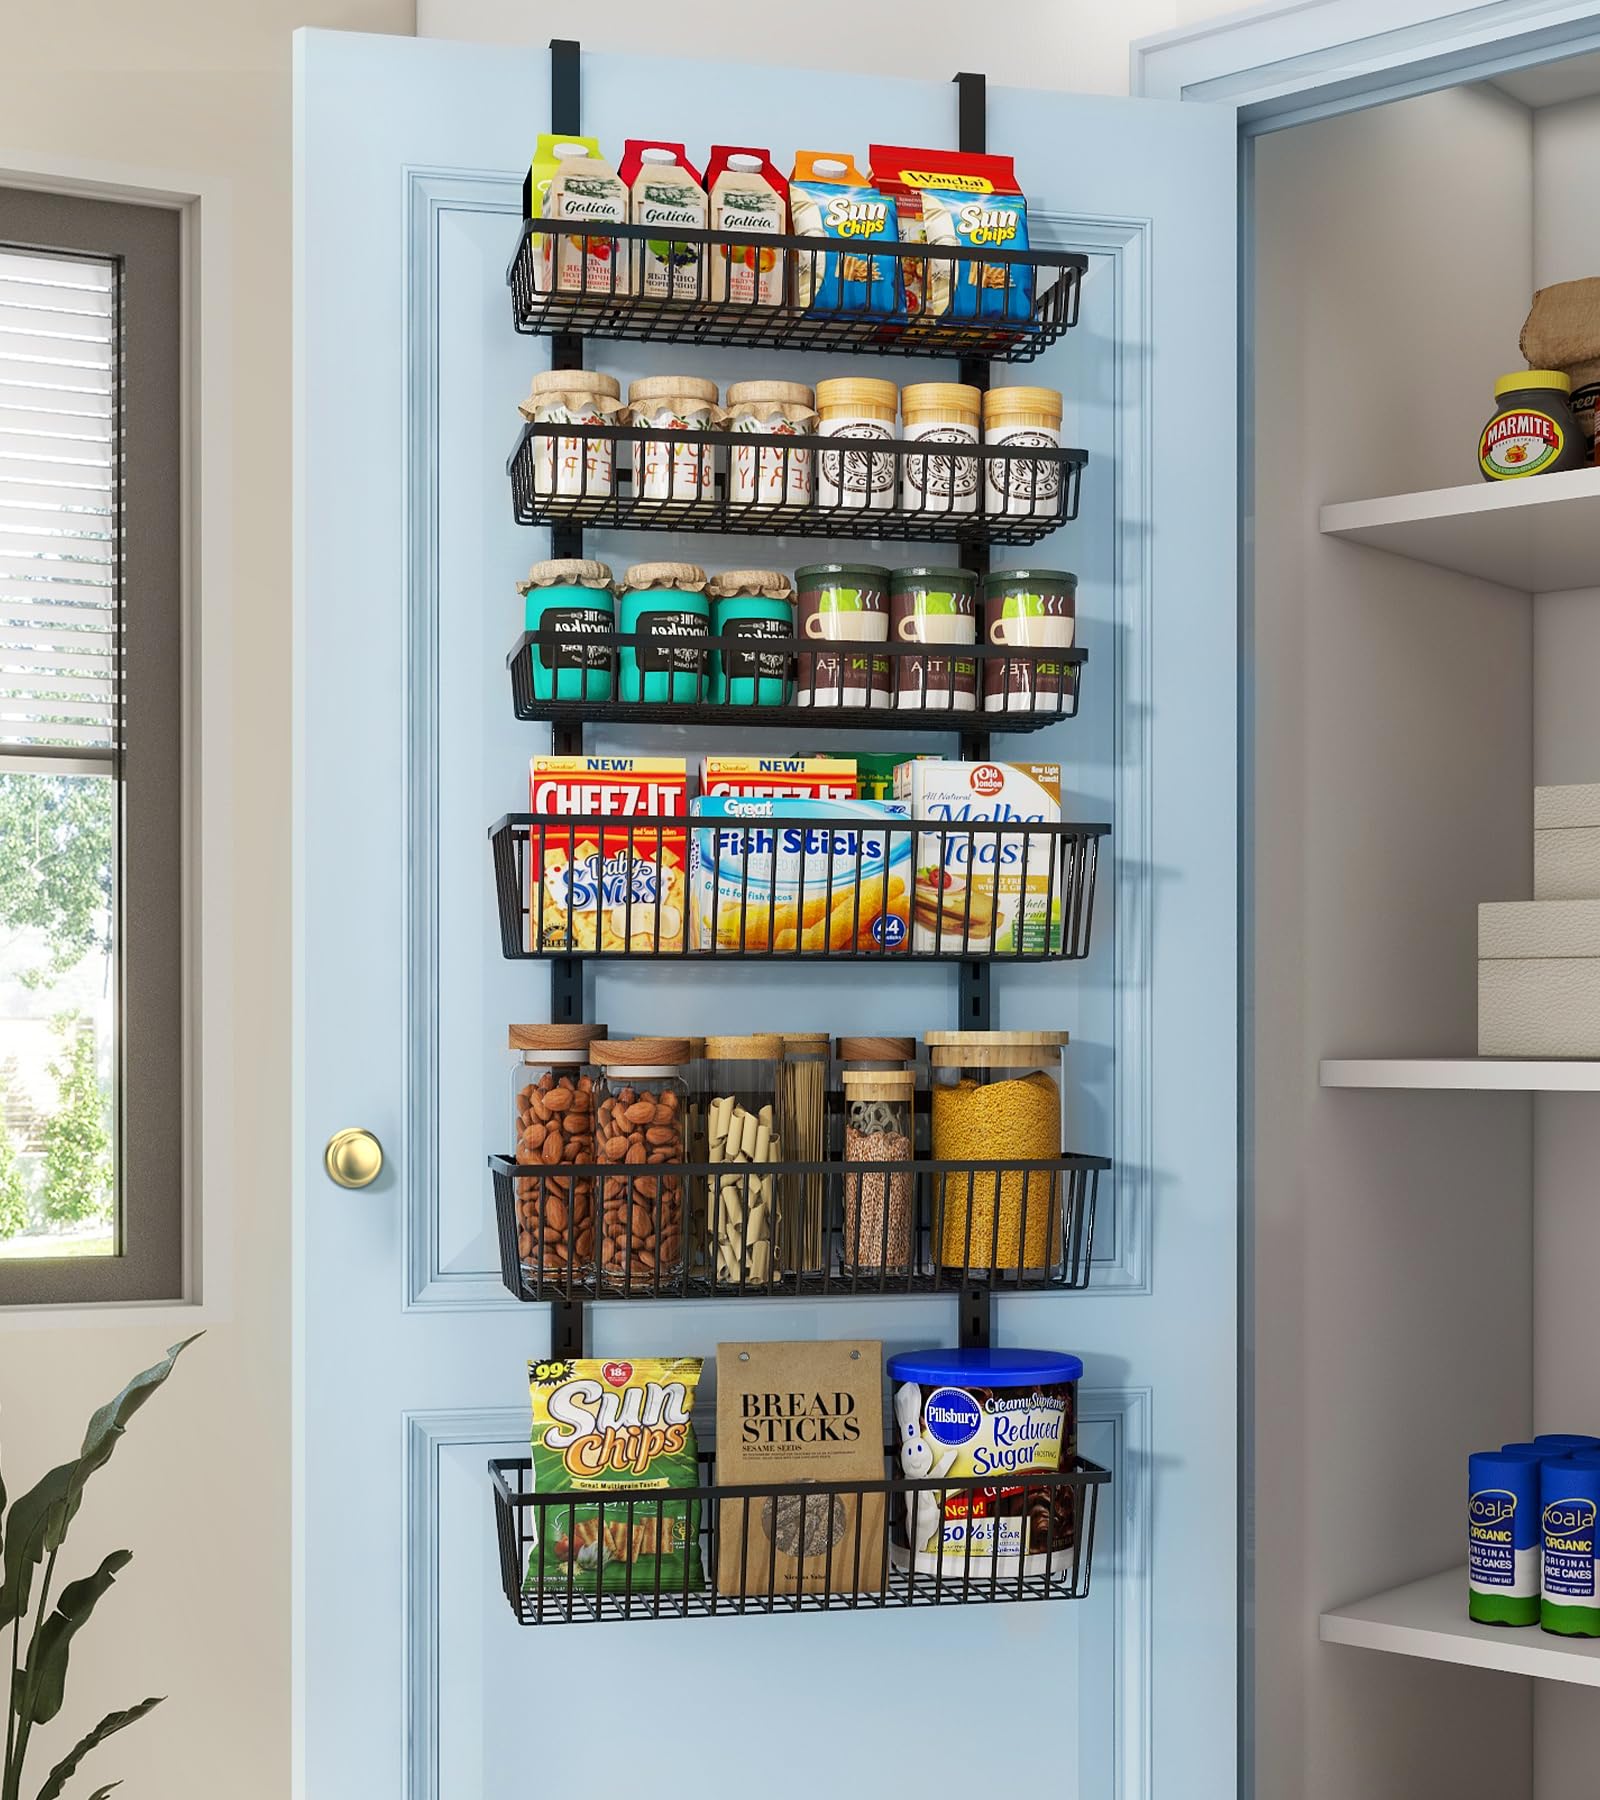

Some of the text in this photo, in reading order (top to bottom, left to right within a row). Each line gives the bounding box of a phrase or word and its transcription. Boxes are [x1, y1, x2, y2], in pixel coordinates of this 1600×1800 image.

[907, 172, 984, 187] Wanchai
[564, 200, 619, 216] Galicia
[645, 208, 700, 224] Galicia
[826, 199, 888, 228] Sun
[723, 214, 775, 229] Galicia
[837, 218, 885, 239] Chips
[957, 207, 1019, 235] Sun
[970, 225, 1017, 246] Chips
[1487, 415, 1550, 447] MARMITE
[586, 758, 634, 771] NEW!
[759, 760, 805, 772] NEW!
[978, 767, 998, 780] Old
[973, 771, 1003, 792] London
[724, 799, 774, 816] Great
[713, 829, 882, 858] Fish Sticks
[936, 834, 1036, 867] Toast
[584, 850, 653, 881] Baby
[563, 866, 665, 908] Swiss
[544, 1379, 691, 1449] Sun
[740, 1392, 855, 1418] BREAD
[985, 1392, 1066, 1415] Creamy Supreme
[928, 1406, 979, 1427] Pillsbury
[741, 1416, 861, 1443] STICKS
[993, 1415, 1061, 1447] Reduced
[563, 1423, 688, 1477] Chips
[776, 1443, 802, 1452] SEEDS
[973, 1443, 1040, 1475] Sugar
[600, 1482, 639, 1490] Multigrain
[944, 1502, 984, 1517] New!
[986, 1531, 1020, 1540] SGAR
[1470, 1526, 1512, 1542] ORGANIC
[1545, 1536, 1592, 1552] ORGANIC
[1482, 1557, 1513, 1570] CAKES
[1545, 1556, 1592, 1568] ORIGINAL
[1545, 1566, 1592, 1579] RICE CAKES
